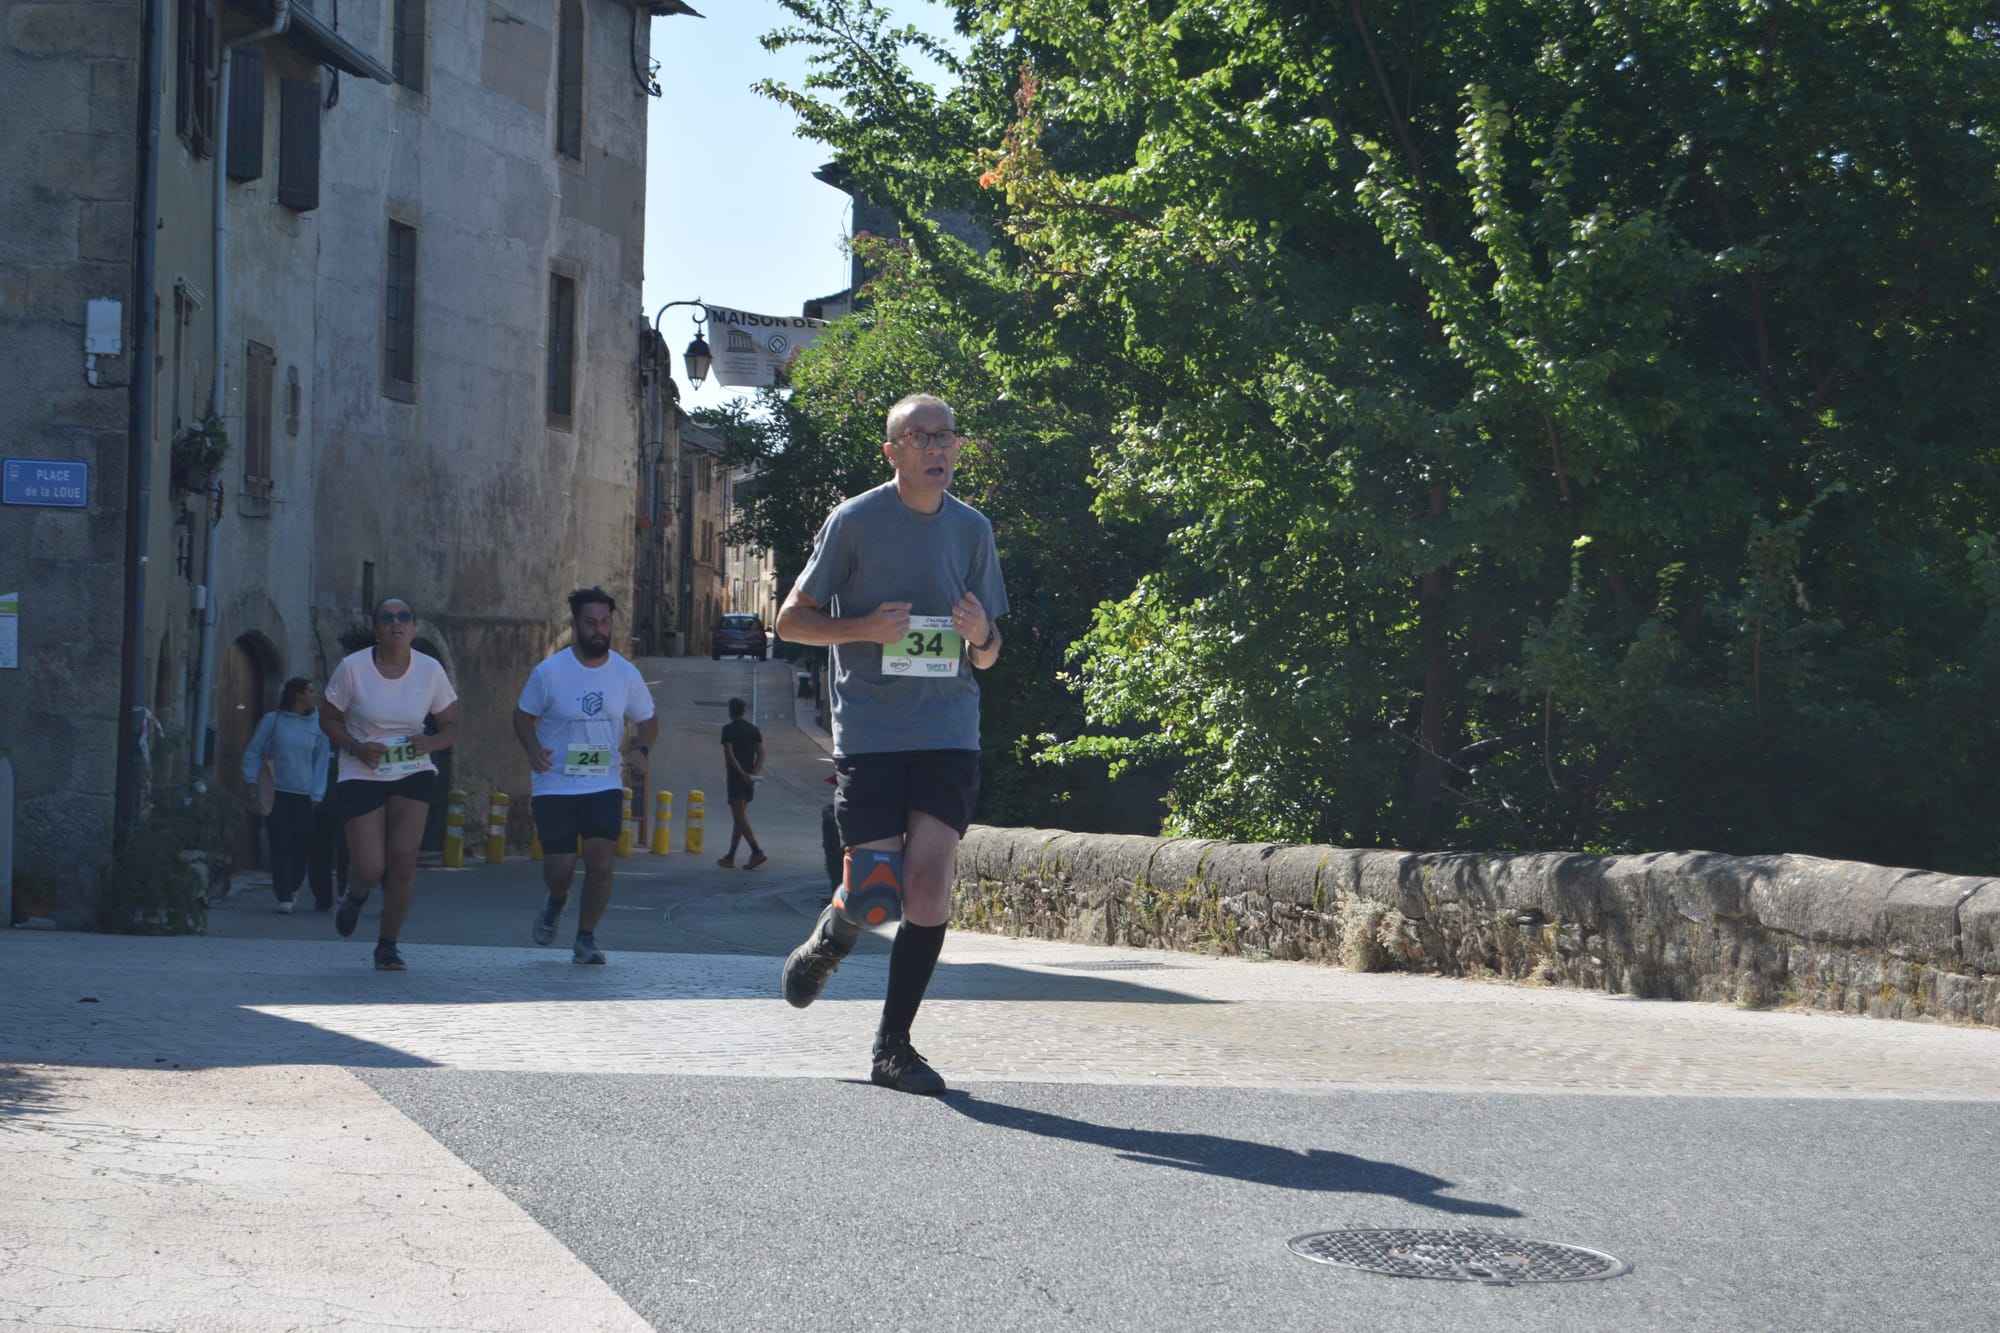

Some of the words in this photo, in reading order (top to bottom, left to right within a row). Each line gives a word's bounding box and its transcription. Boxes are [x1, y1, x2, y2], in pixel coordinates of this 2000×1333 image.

[712, 309, 788, 328] MAISON
[793, 318, 817, 329] DE
[36, 468, 71, 481] PLACE
[25, 485, 38, 497] de
[41, 485, 50, 497] la
[54, 486, 81, 498] LOUE
[906, 632, 943, 656] 34
[578, 751, 600, 765] 24
